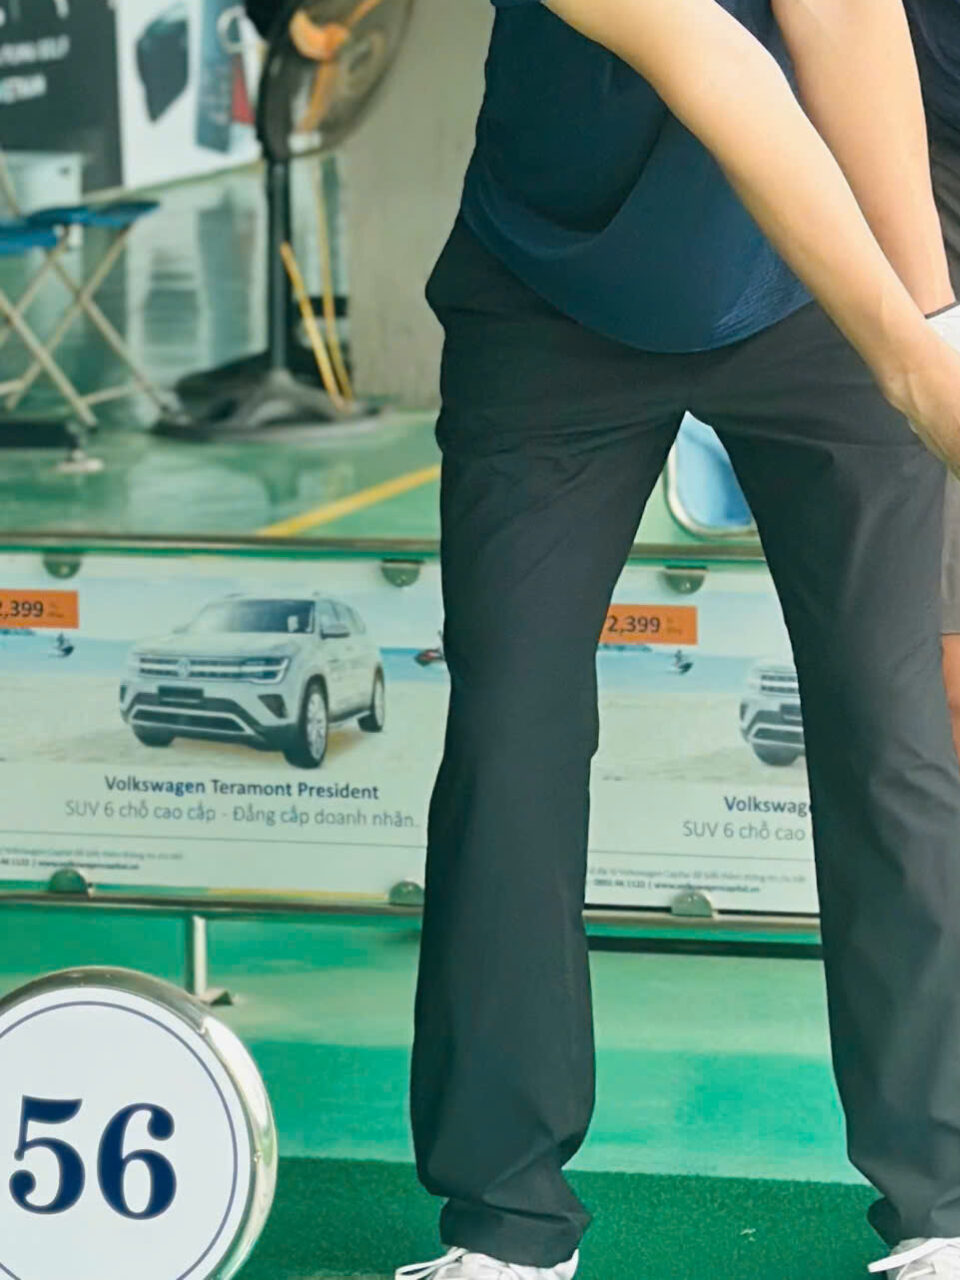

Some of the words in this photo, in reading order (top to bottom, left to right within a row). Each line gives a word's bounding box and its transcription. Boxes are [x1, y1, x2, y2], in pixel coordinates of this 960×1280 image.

[0, 599, 44, 620] ,399
[607, 614, 661, 637] 2,399
[104, 774, 206, 797] Volkswagen
[211, 778, 293, 797] Teramont
[298, 782, 379, 800] President
[65, 800, 99, 817] SUV
[103, 801, 115, 818] 6
[153, 805, 183, 821] cao
[314, 808, 367, 826] doanh
[724, 796, 812, 818] Volkswag
[682, 820, 719, 838] SUV
[723, 822, 735, 839] 6
[775, 827, 806, 841] cao
[8, 1094, 178, 1221] 56
